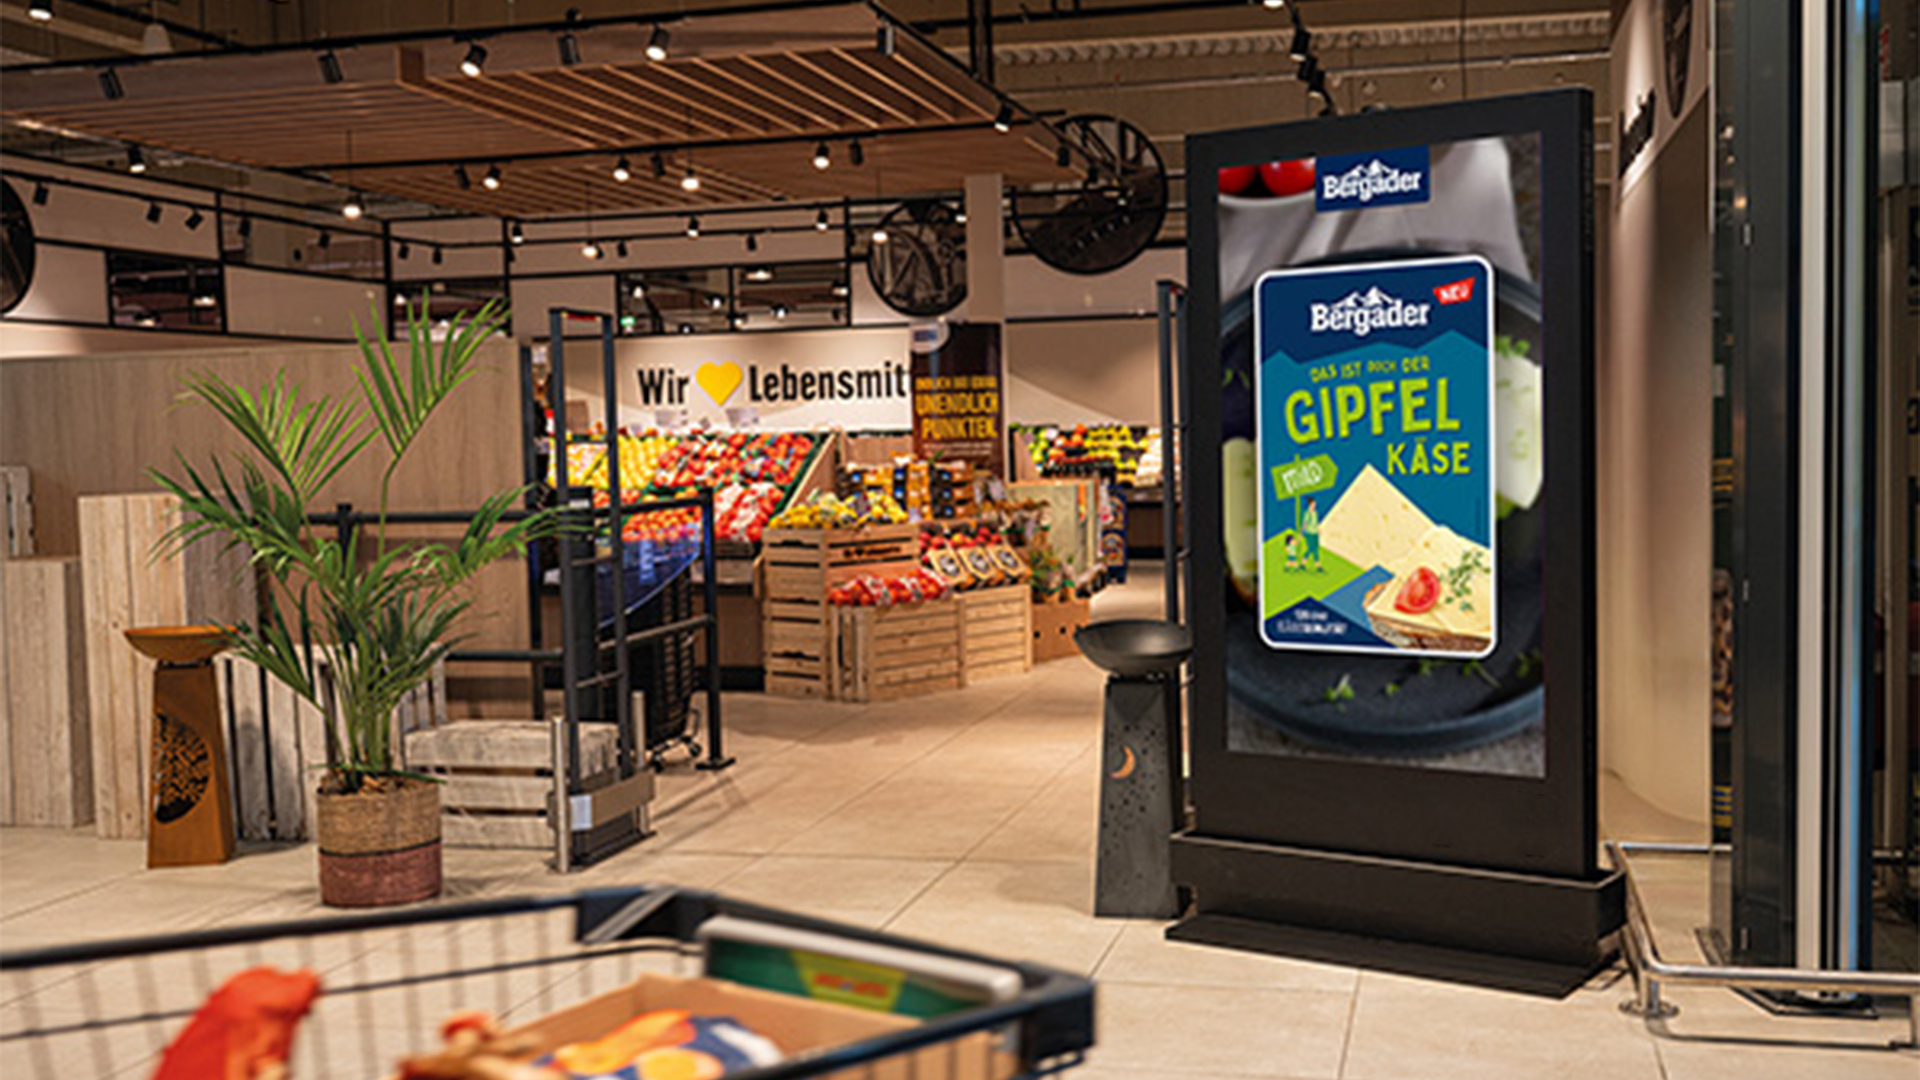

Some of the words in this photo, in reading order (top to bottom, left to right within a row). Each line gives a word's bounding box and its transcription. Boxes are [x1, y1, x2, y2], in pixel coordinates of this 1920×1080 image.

[1322, 169, 1422, 202] Bergader
[1439, 283, 1470, 302] NEU
[1310, 302, 1430, 336] Bergader
[1310, 364, 1338, 383] DAS
[1341, 361, 1362, 379] IST
[1402, 355, 1431, 373] DER
[637, 369, 689, 404] Wir
[915, 392, 999, 415] UNENDLICH
[1284, 376, 1461, 445] GIPFEL
[1386, 437, 1471, 476] KÄSE
